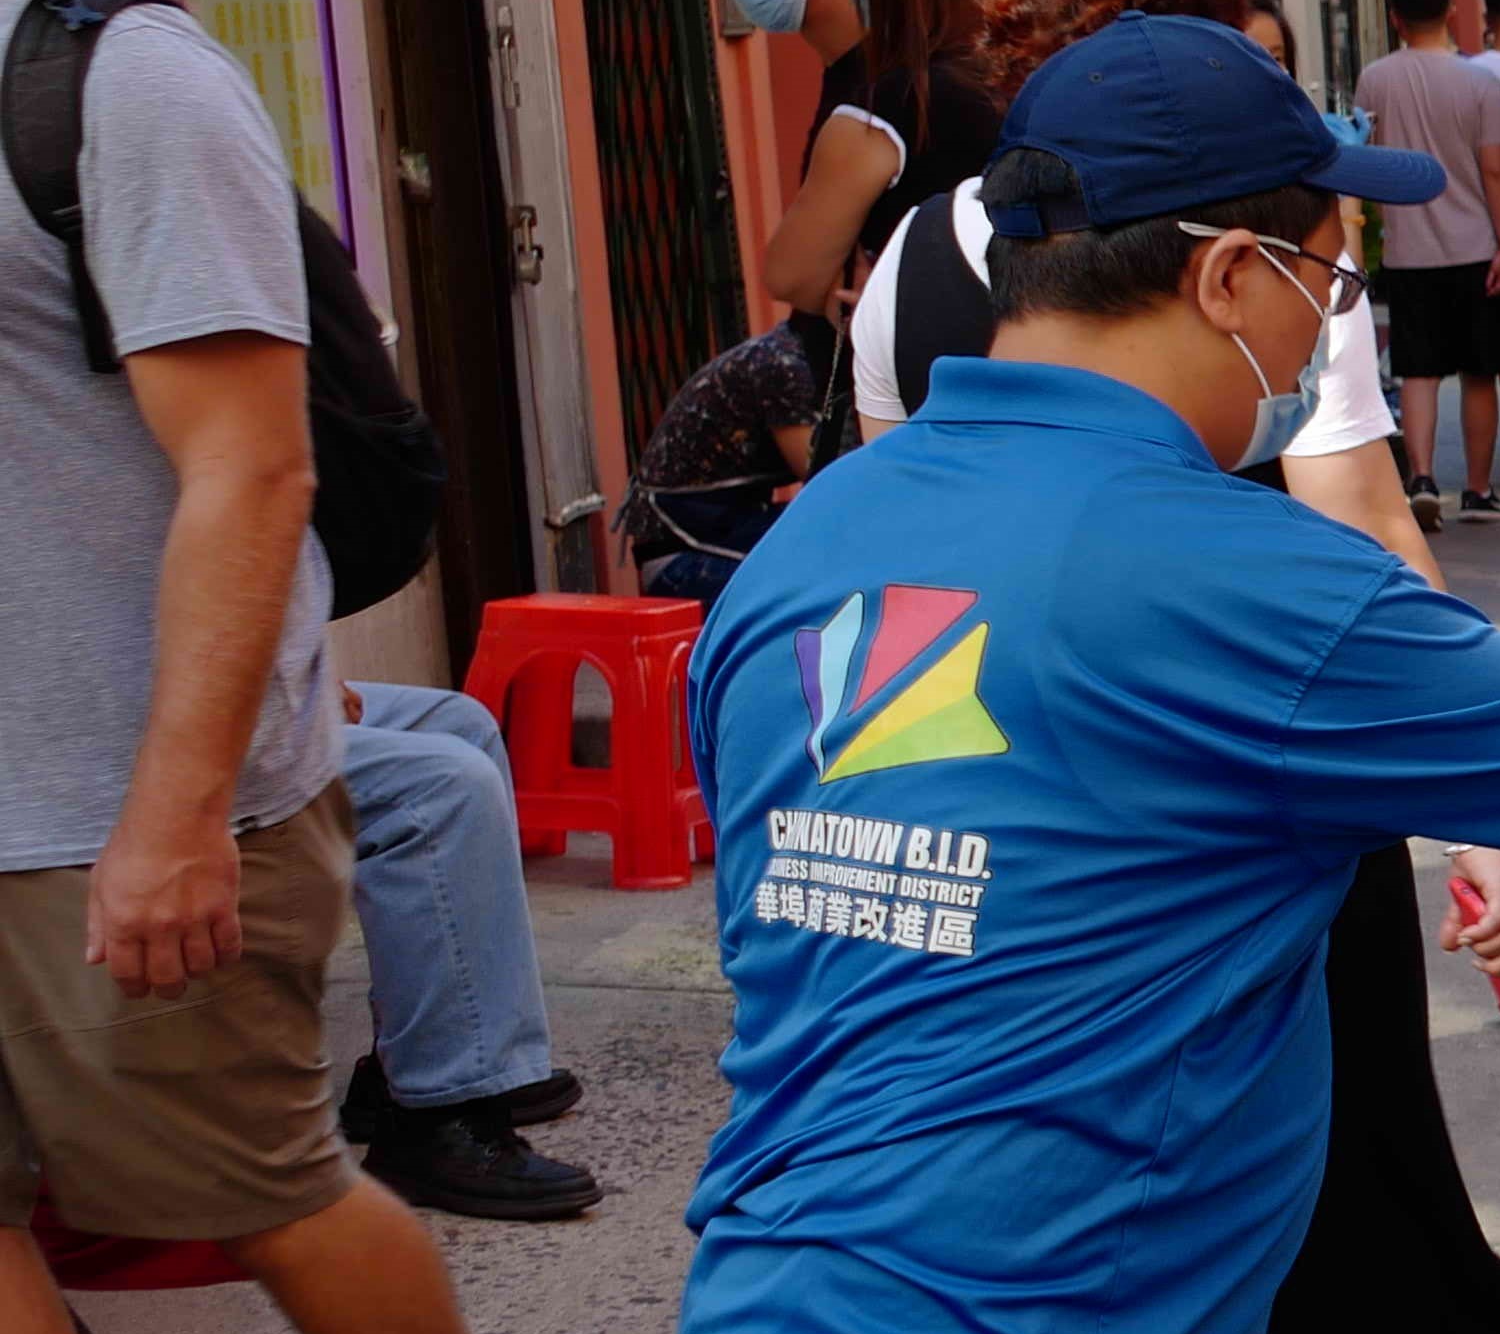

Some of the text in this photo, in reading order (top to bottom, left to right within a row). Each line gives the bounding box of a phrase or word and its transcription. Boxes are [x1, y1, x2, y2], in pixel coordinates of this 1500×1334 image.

[904, 827, 993, 880] B.I.D.
[809, 860, 899, 895] IMPROVEMENT
[900, 876, 984, 908] DISTRICT
[756, 881, 978, 957] 華埠商業改進區
